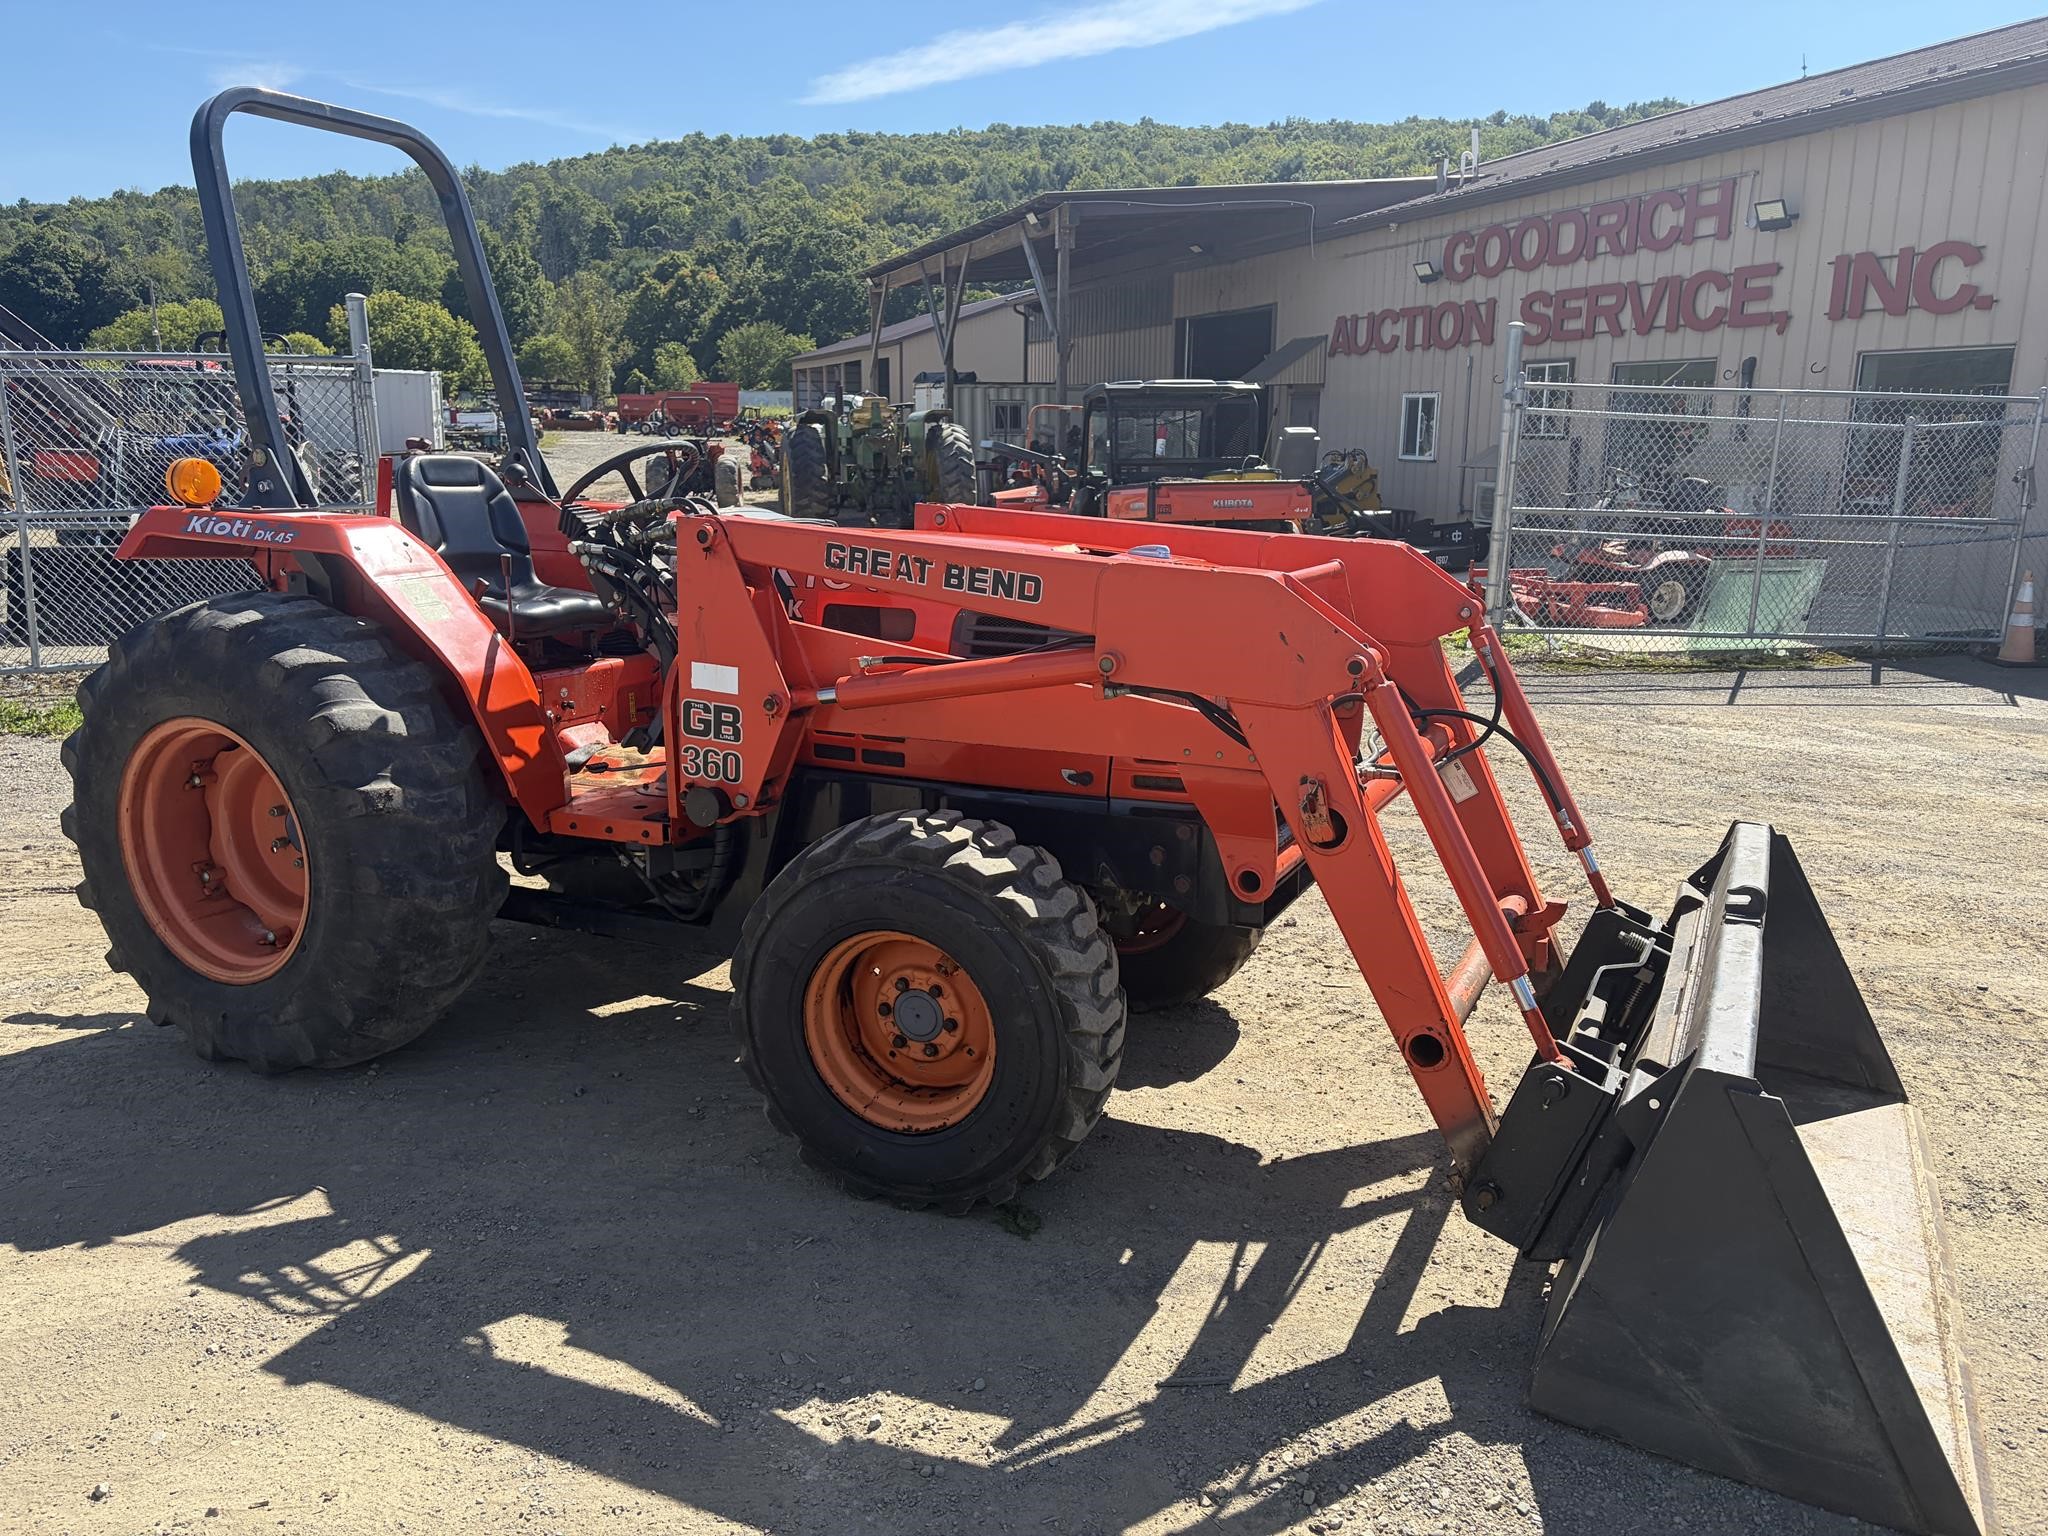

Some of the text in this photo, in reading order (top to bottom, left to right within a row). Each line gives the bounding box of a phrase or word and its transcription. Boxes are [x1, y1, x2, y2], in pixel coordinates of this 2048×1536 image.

[1443, 178, 1737, 282] GOODRICH
[1328, 240, 1994, 357] AUCTION SERVICE, INC.
[187, 515, 252, 538] Kioti
[1212, 498, 1254, 508] KUBOTA
[824, 541, 935, 586] GREAT
[942, 562, 1044, 605] BEND
[682, 698, 743, 745] GB
[682, 744, 742, 784] 360
